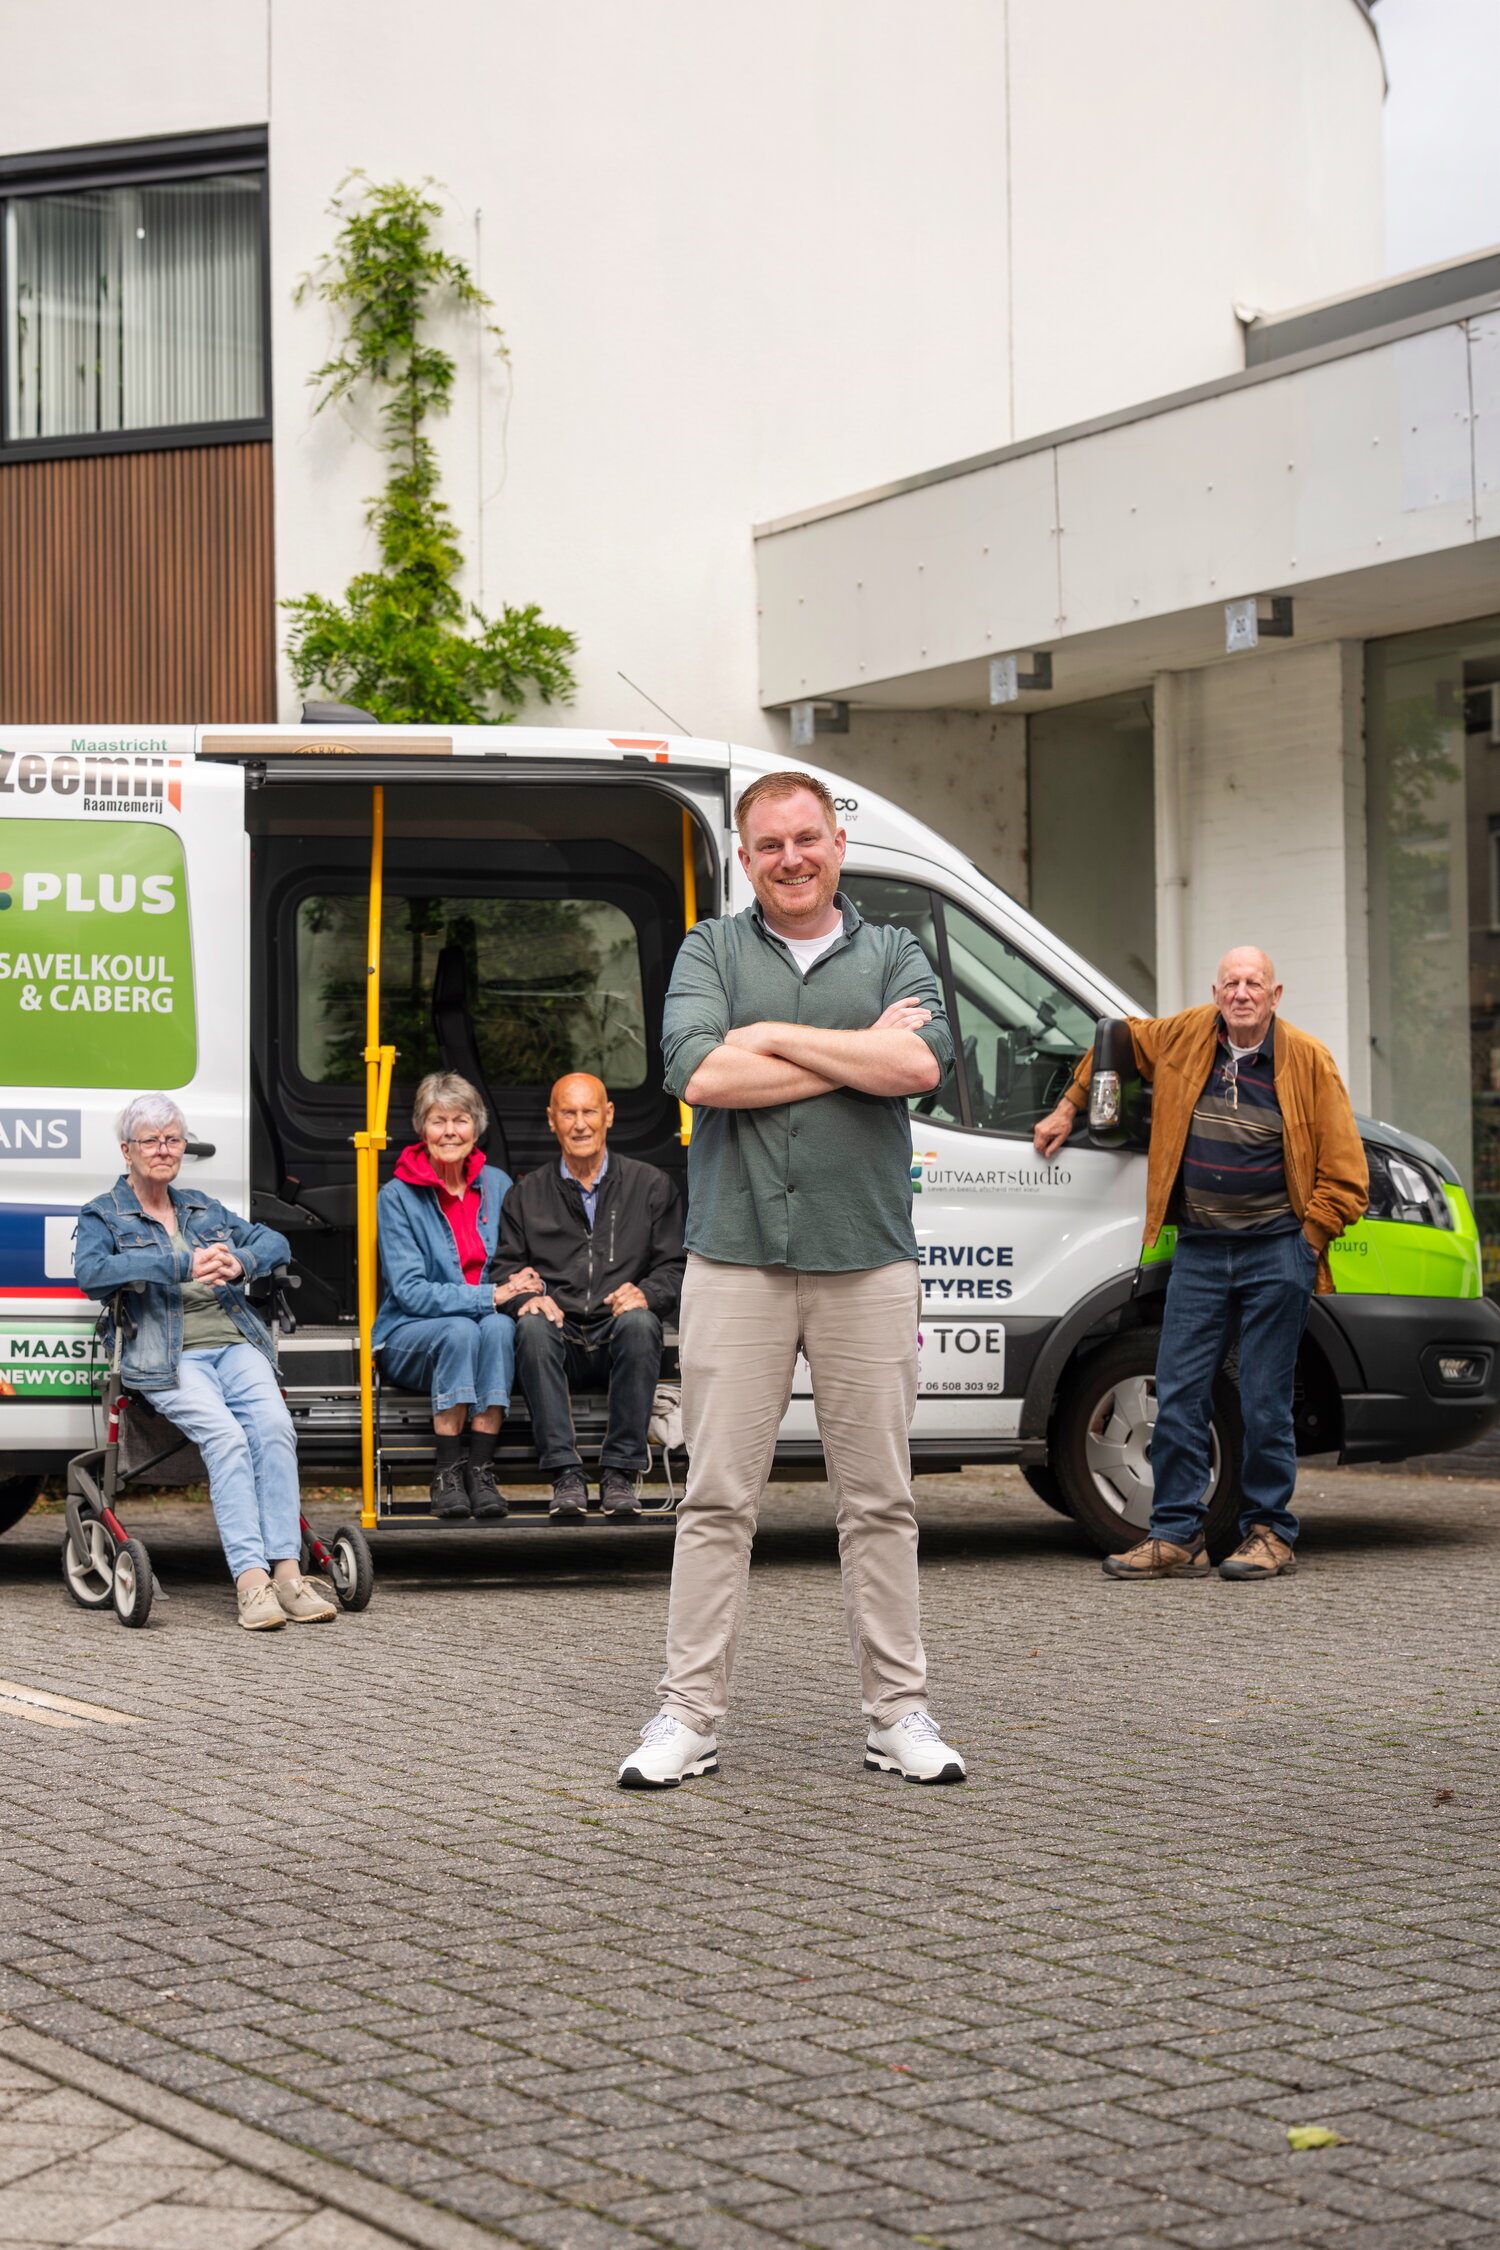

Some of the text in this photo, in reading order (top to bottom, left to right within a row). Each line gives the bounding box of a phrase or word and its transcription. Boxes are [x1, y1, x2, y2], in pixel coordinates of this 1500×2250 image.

[71, 738, 168, 751] Maastricht
[83, 798, 163, 814] Raamzemerij
[844, 813, 858, 821] bv
[22, 872, 176, 915] PLUS
[0, 952, 174, 983] SAVELKOUL
[19, 984, 173, 1014] & CABERG
[927, 1165, 1072, 1186] UITVAARTstudio
[1330, 1240, 1369, 1257] burg
[921, 1279, 1013, 1299] TYRES
[11, 1339, 109, 1359] MAAST
[933, 1328, 1001, 1354] TOE
[925, 1382, 939, 1391] 06
[942, 1382, 962, 1391] 508
[964, 1382, 984, 1391] 303
[986, 1382, 1000, 1391] 92
